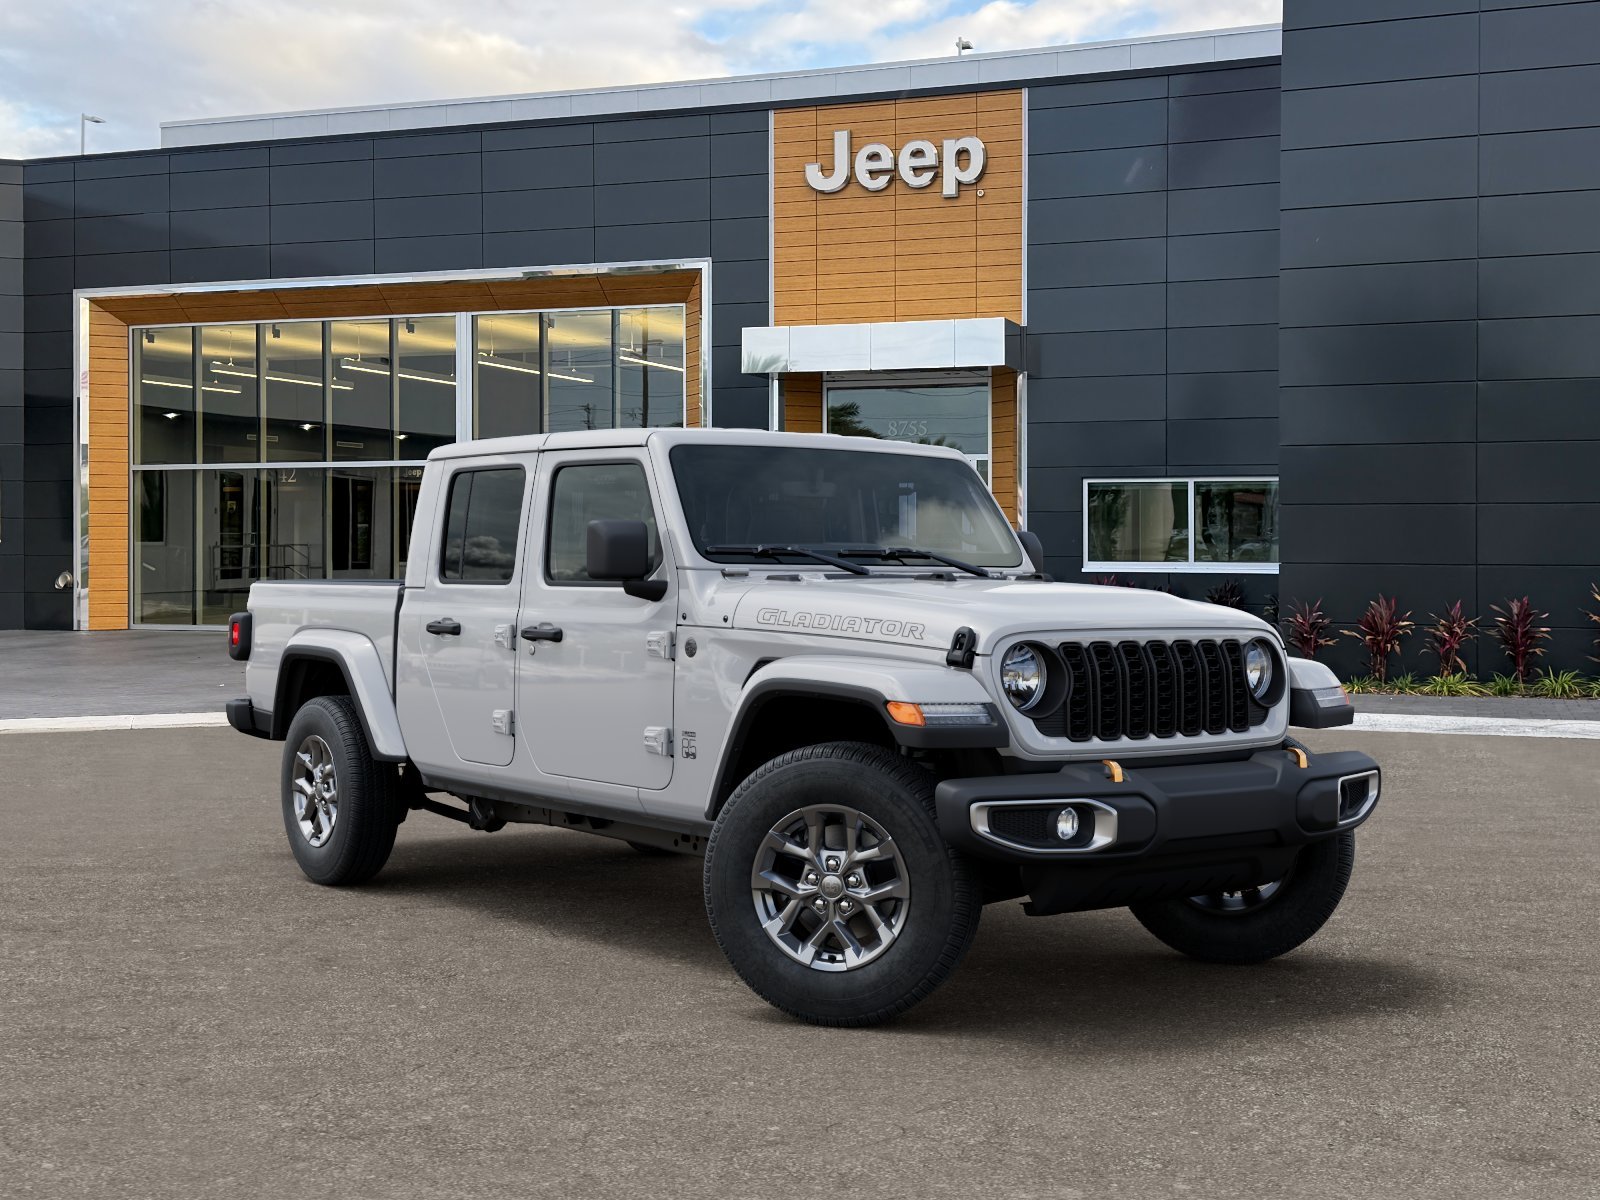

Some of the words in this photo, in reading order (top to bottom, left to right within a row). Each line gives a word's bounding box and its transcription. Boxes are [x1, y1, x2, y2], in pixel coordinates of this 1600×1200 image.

[805, 128, 988, 198] Jeep
[888, 420, 928, 437] 8755
[756, 607, 926, 640] GLADIATOR
